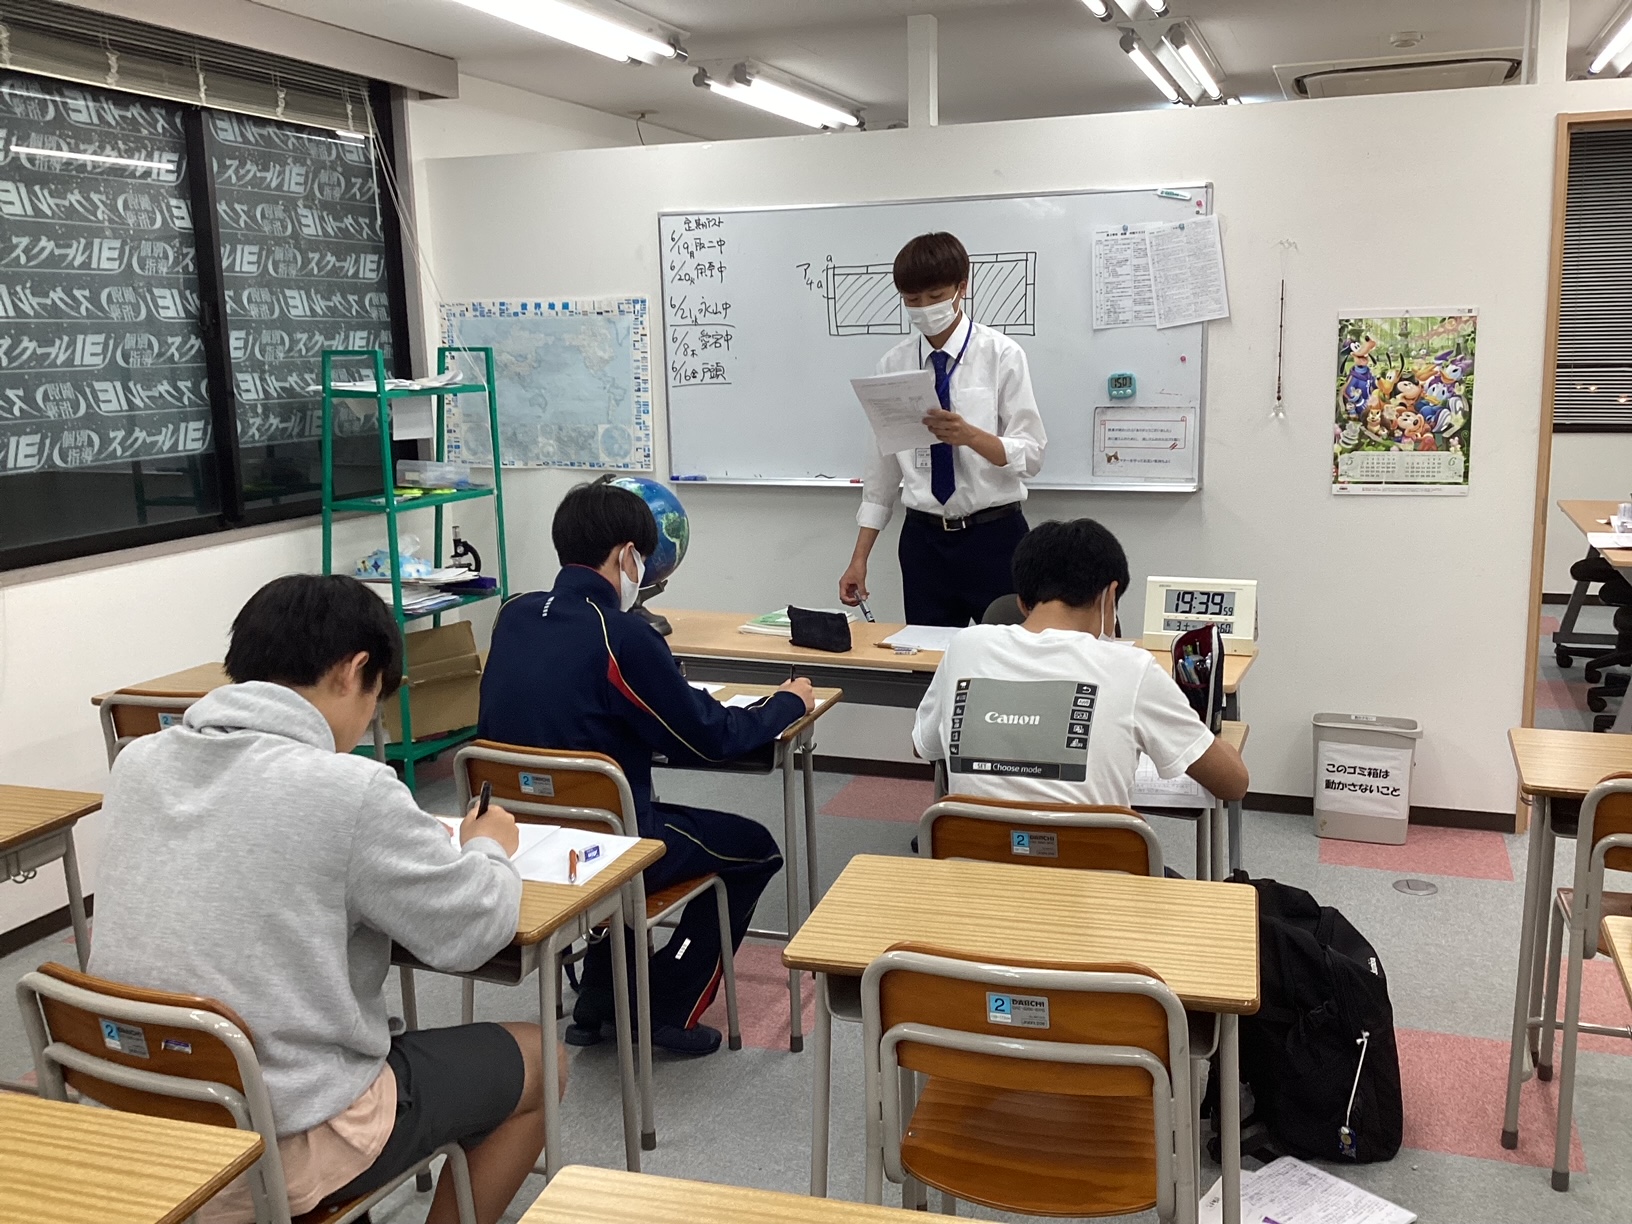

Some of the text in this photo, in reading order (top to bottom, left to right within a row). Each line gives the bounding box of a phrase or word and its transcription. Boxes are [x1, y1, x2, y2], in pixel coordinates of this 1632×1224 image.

[0, 236, 122, 269] スクールIE
[301, 251, 380, 279] スクールIE
[101, 420, 206, 459] スクールIE
[1175, 591, 1234, 616] 19:39 59
[163, 716, 170, 725] 2
[984, 711, 1040, 725] Canon
[992, 763, 1020, 772] Choose
[1021, 766, 1043, 774] mode
[1325, 763, 1390, 779] このゴミ箱は
[522, 775, 530, 786] 2
[1324, 779, 1401, 797] 動かさないこと
[1016, 834, 1025, 846] 2
[994, 998, 1005, 1012] 2
[105, 1024, 115, 1038] 2
